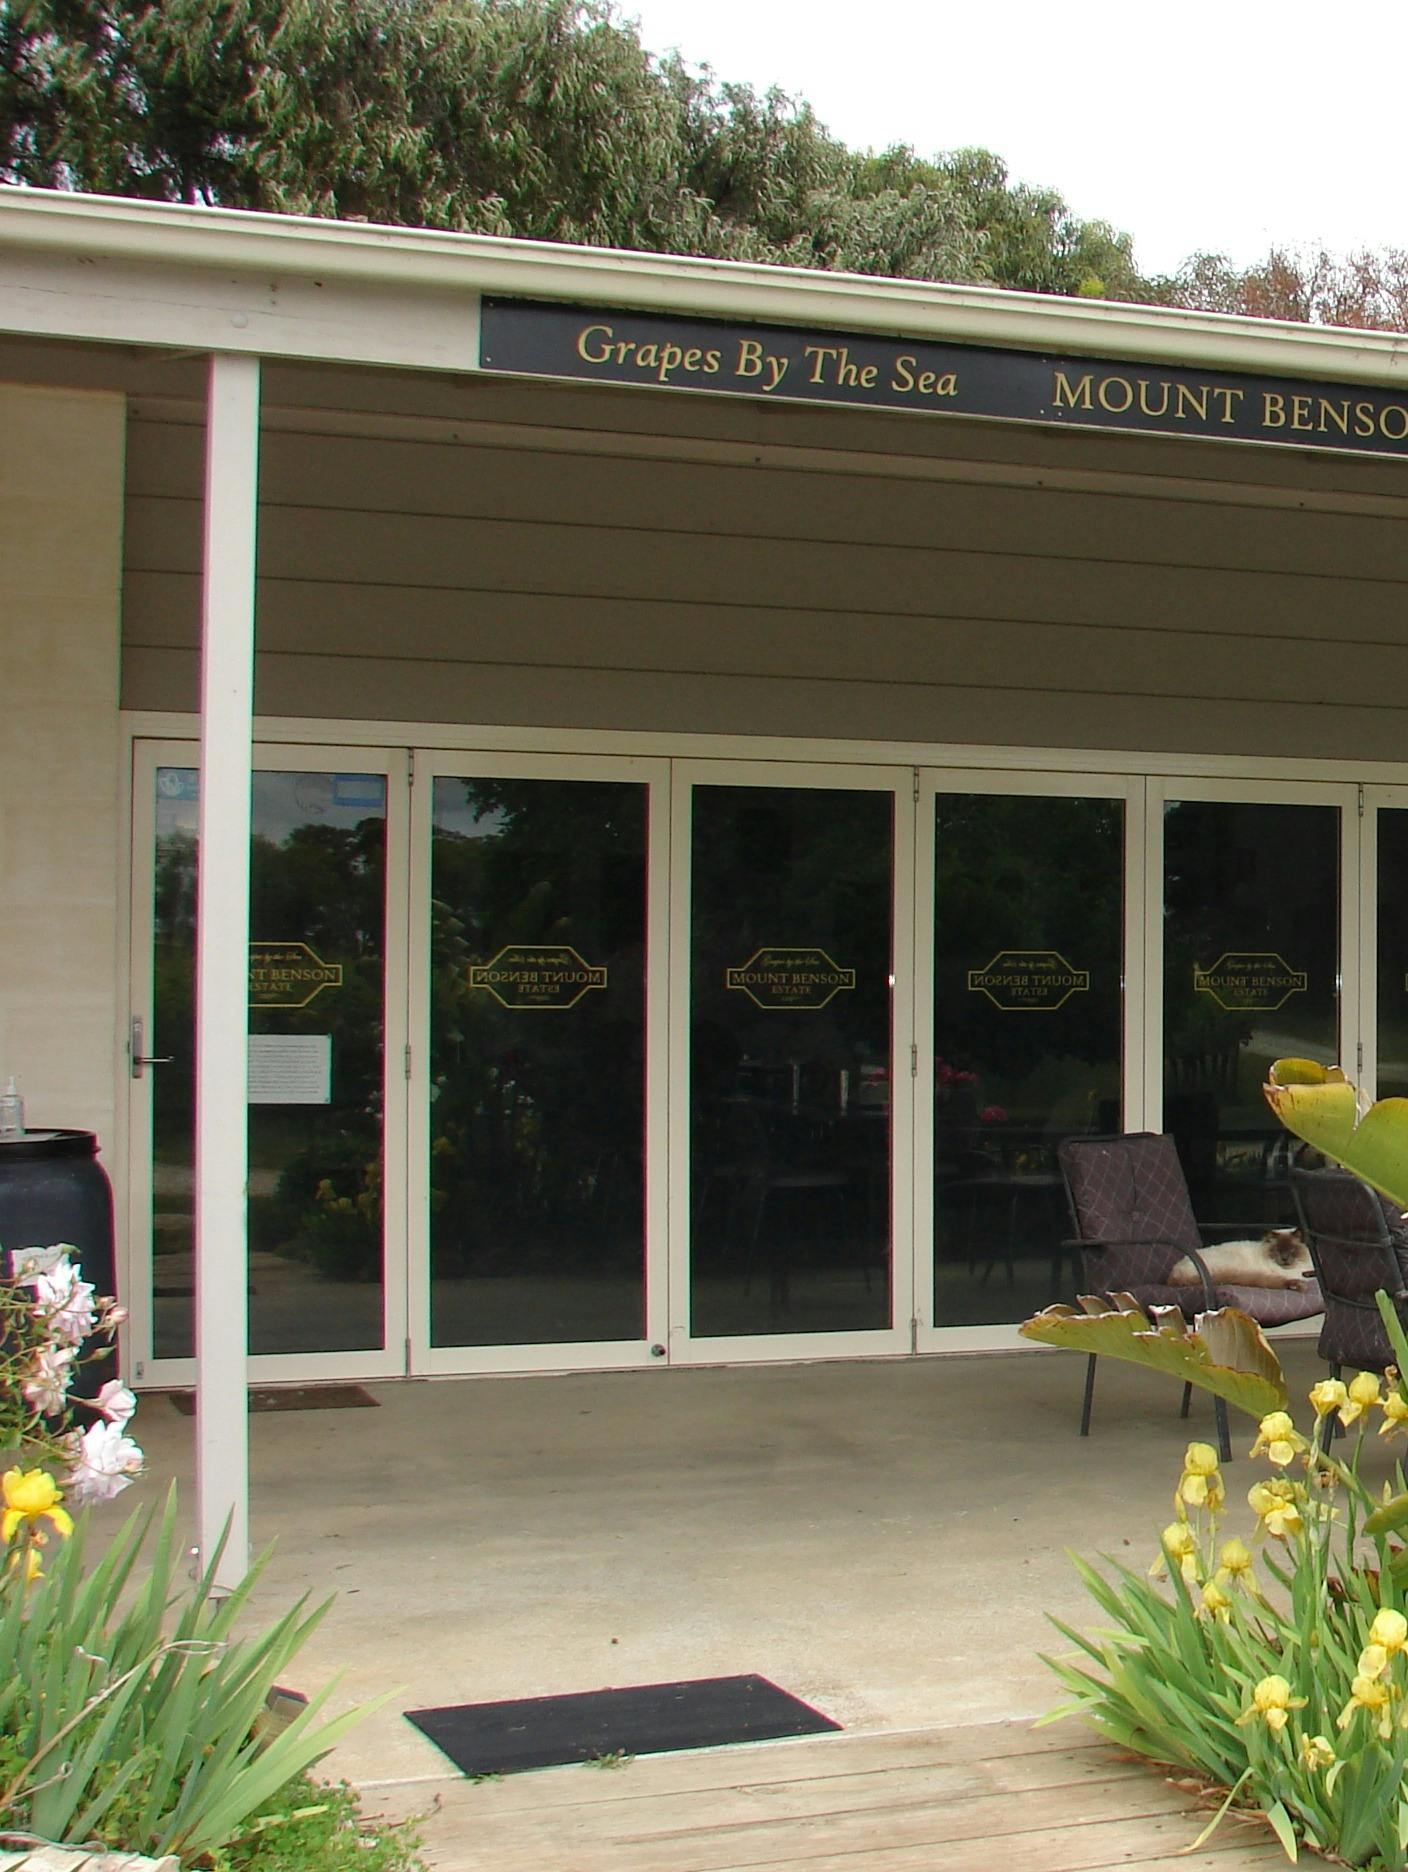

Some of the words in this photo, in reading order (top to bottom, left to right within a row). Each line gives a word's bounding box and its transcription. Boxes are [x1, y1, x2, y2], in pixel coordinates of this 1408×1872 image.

[576, 324, 722, 381] Grapes
[736, 340, 789, 392] By
[805, 345, 879, 389] The
[891, 355, 959, 396] Sea
[1052, 371, 1244, 423] MOUNT
[271, 968, 336, 981] BENSON
[732, 972, 790, 984] MOUNT
[792, 972, 849, 985] BENSON
[1199, 976, 1247, 986] MOUNT
[1252, 976, 1302, 987] BENSON
[771, 985, 812, 994] ESTATE
